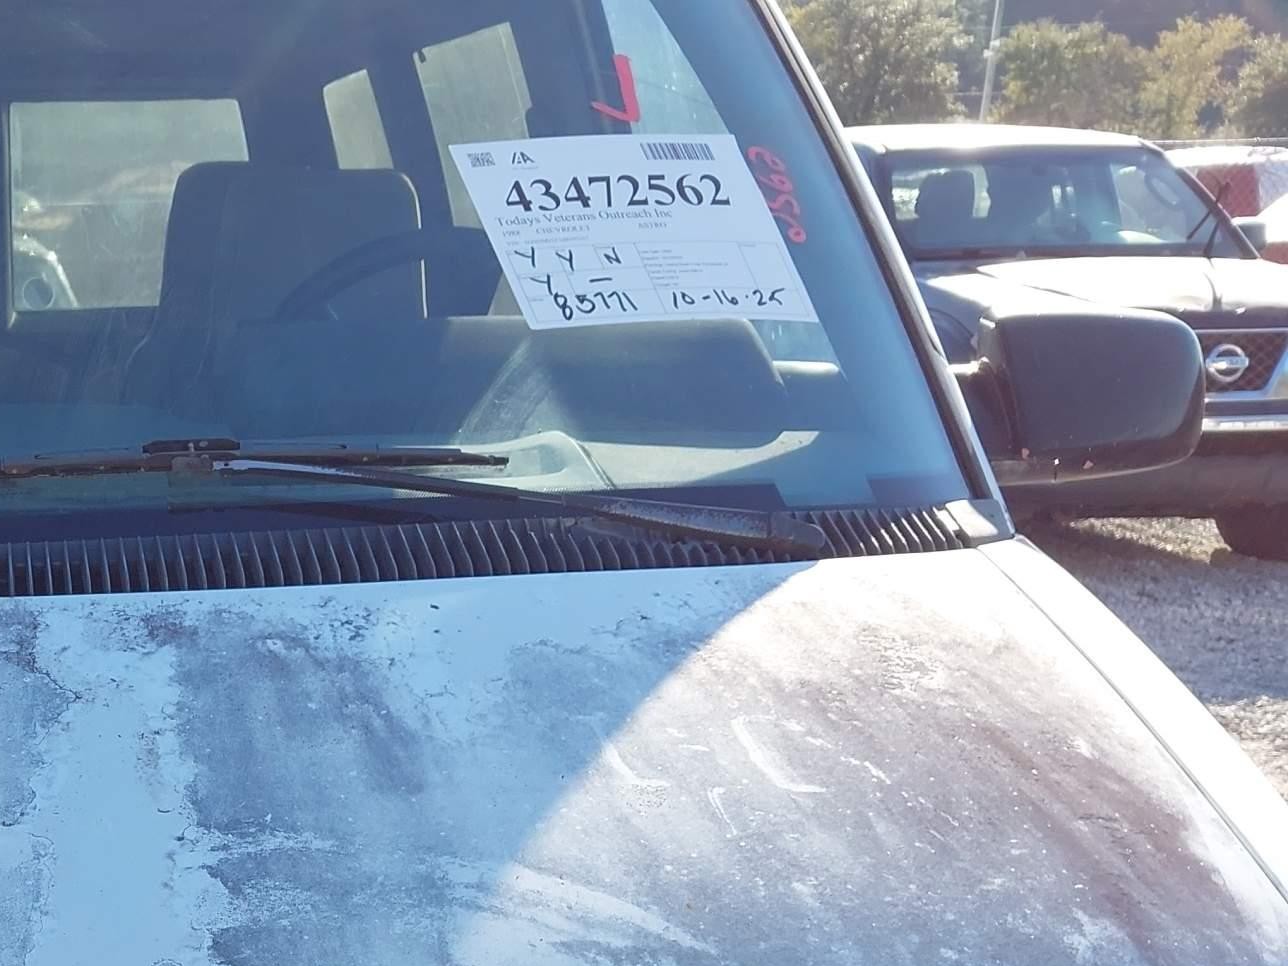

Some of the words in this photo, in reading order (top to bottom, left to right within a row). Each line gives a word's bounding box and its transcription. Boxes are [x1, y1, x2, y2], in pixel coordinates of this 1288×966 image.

[506, 173, 731, 212] 43472562
[495, 214, 541, 228] Todays
[542, 211, 597, 223] Veterans
[598, 208, 652, 220] Outreach
[655, 208, 673, 218] Inc
[603, 246, 622, 264] N
